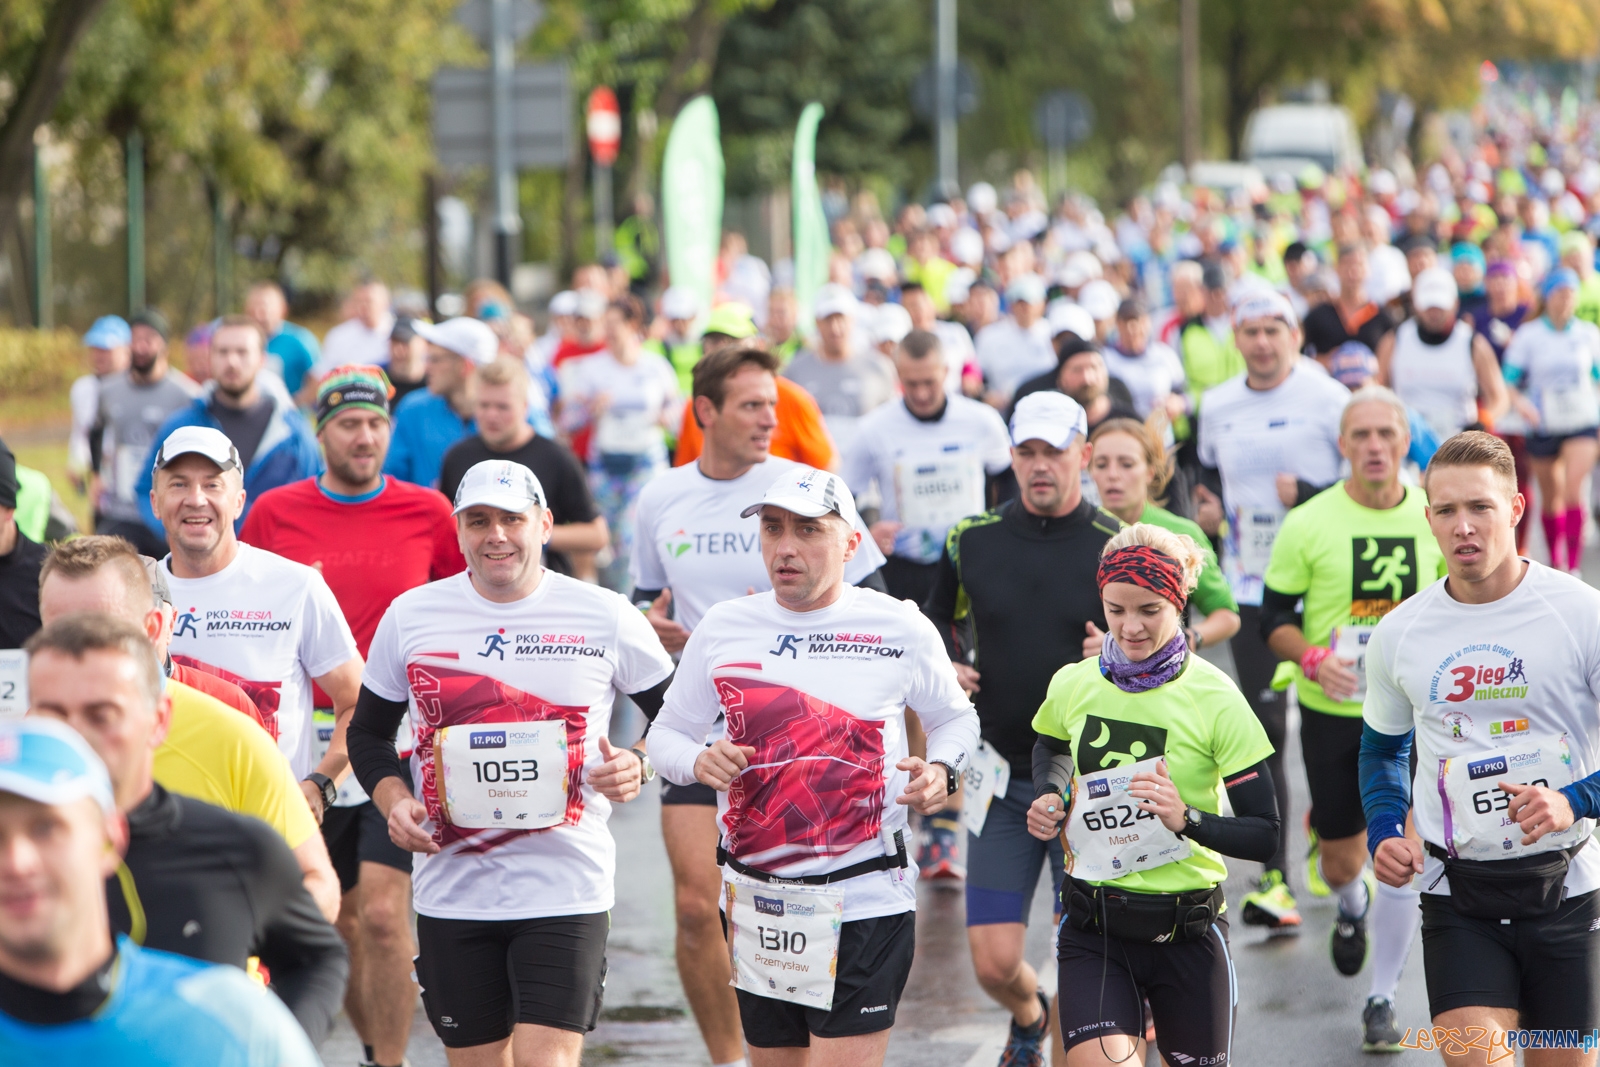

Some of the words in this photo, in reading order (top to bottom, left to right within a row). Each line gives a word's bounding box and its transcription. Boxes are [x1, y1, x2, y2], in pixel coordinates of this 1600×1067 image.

[206, 610, 229, 620] PKO
[230, 610, 272, 620] SILESIA
[206, 621, 292, 631] MARATHON
[516, 634, 540, 643] PKO
[541, 634, 585, 644] SILESIA
[808, 633, 834, 641] PKO
[835, 633, 882, 644] SILESIA
[515, 646, 605, 657] MARATHON
[808, 644, 904, 659] MARATHON
[1429, 675, 1440, 701] Wyrusz
[1439, 653, 1456, 671] nami
[1455, 649, 1462, 658] w
[1474, 686, 1529, 701] mleczny
[472, 759, 539, 783] 1053
[488, 788, 528, 798] Dariusz
[1082, 799, 1157, 832] 6624
[1109, 833, 1140, 846] Marta
[757, 925, 807, 955] 1310
[754, 954, 810, 973] Przemysław
[1077, 1020, 1116, 1034] TRIMTEX
